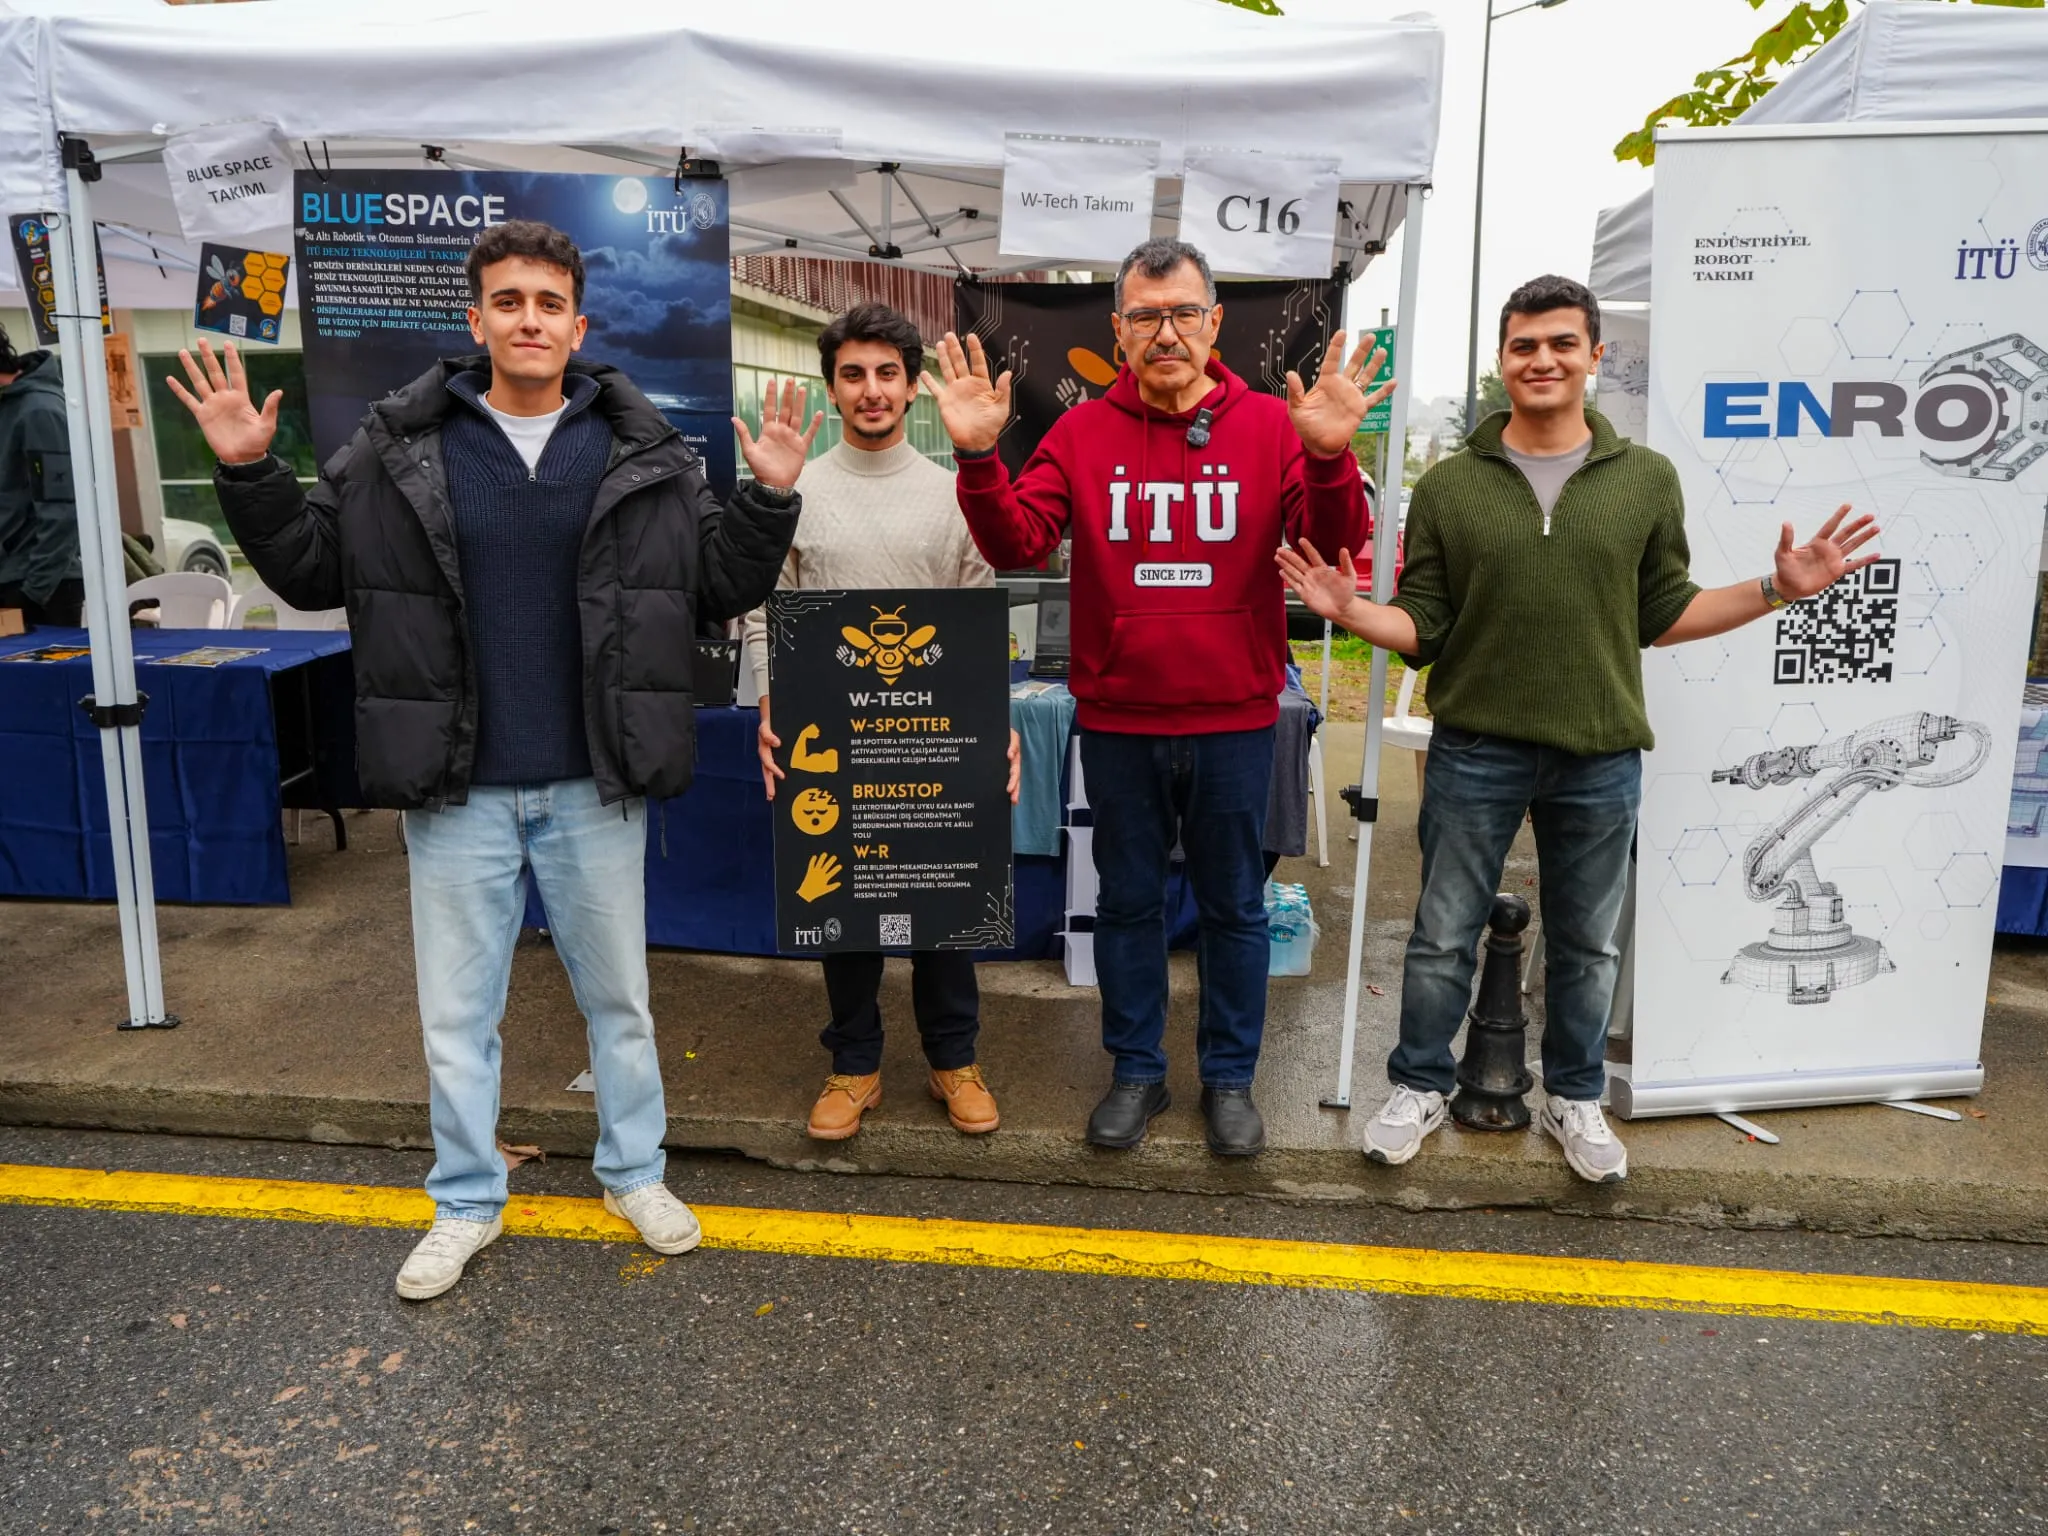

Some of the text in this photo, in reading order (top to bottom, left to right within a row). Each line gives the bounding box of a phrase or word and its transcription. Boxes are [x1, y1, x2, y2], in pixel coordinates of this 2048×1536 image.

[186, 156, 273, 183] BLUE SPACE
[208, 182, 266, 204] TAKIMI
[1021, 191, 1134, 213] W-Tech Takımı
[302, 192, 508, 227] BLUESPACE
[1216, 194, 1303, 236] C16
[645, 204, 687, 233] İTÜ
[304, 231, 314, 241] Su
[316, 231, 331, 241] Altı
[333, 231, 365, 242] Robotik
[366, 234, 377, 242] ve
[378, 232, 414, 244] Otonom
[416, 233, 471, 245] Sistemlerin
[1694, 234, 1812, 250] ENDÜSTRİYEL
[306, 245, 320, 256] İTÜ
[322, 246, 350, 257] DENİZ
[313, 260, 344, 270] DENİZİN
[404, 264, 434, 273] NEDEN
[1693, 254, 1753, 265] ROBOT
[1954, 239, 2020, 280] İTÜ
[313, 272, 337, 281] DENİZ
[418, 276, 450, 286] ATILAN
[1693, 270, 1755, 282] TAKIMI
[314, 283, 351, 293] SAVUNMA
[385, 284, 403, 296] İÇİN
[405, 287, 418, 296] NE
[419, 287, 456, 297] ANLAMA
[315, 295, 358, 305] BLUESPACE
[359, 296, 391, 306] OLARAK
[393, 297, 407, 307] BİZ
[409, 298, 421, 307] NE
[317, 316, 331, 326] BİR
[332, 317, 360, 327] VİZYON
[388, 308, 403, 318] BİR
[404, 310, 450, 321] ORTAMDA,
[318, 328, 333, 337] VAR
[1703, 381, 1993, 442] ENRO
[1108, 464, 1240, 543] İTÜ
[1139, 568, 1204, 581] SINCE 1773
[849, 691, 933, 707] W-TECH
[850, 717, 951, 733] W-SPOTTER
[925, 737, 964, 745] DUYMADAN
[964, 736, 978, 744] KAS
[852, 783, 944, 798] BRUXSTOP
[916, 802, 936, 811] UYKU
[943, 820, 953, 828] VE
[852, 831, 872, 840] YOLU
[853, 844, 890, 859] W-R
[853, 872, 875, 881] SANAL
[876, 872, 885, 880] VE
[937, 880, 972, 889] DOKUNMA
[794, 926, 823, 945] İTÜ
